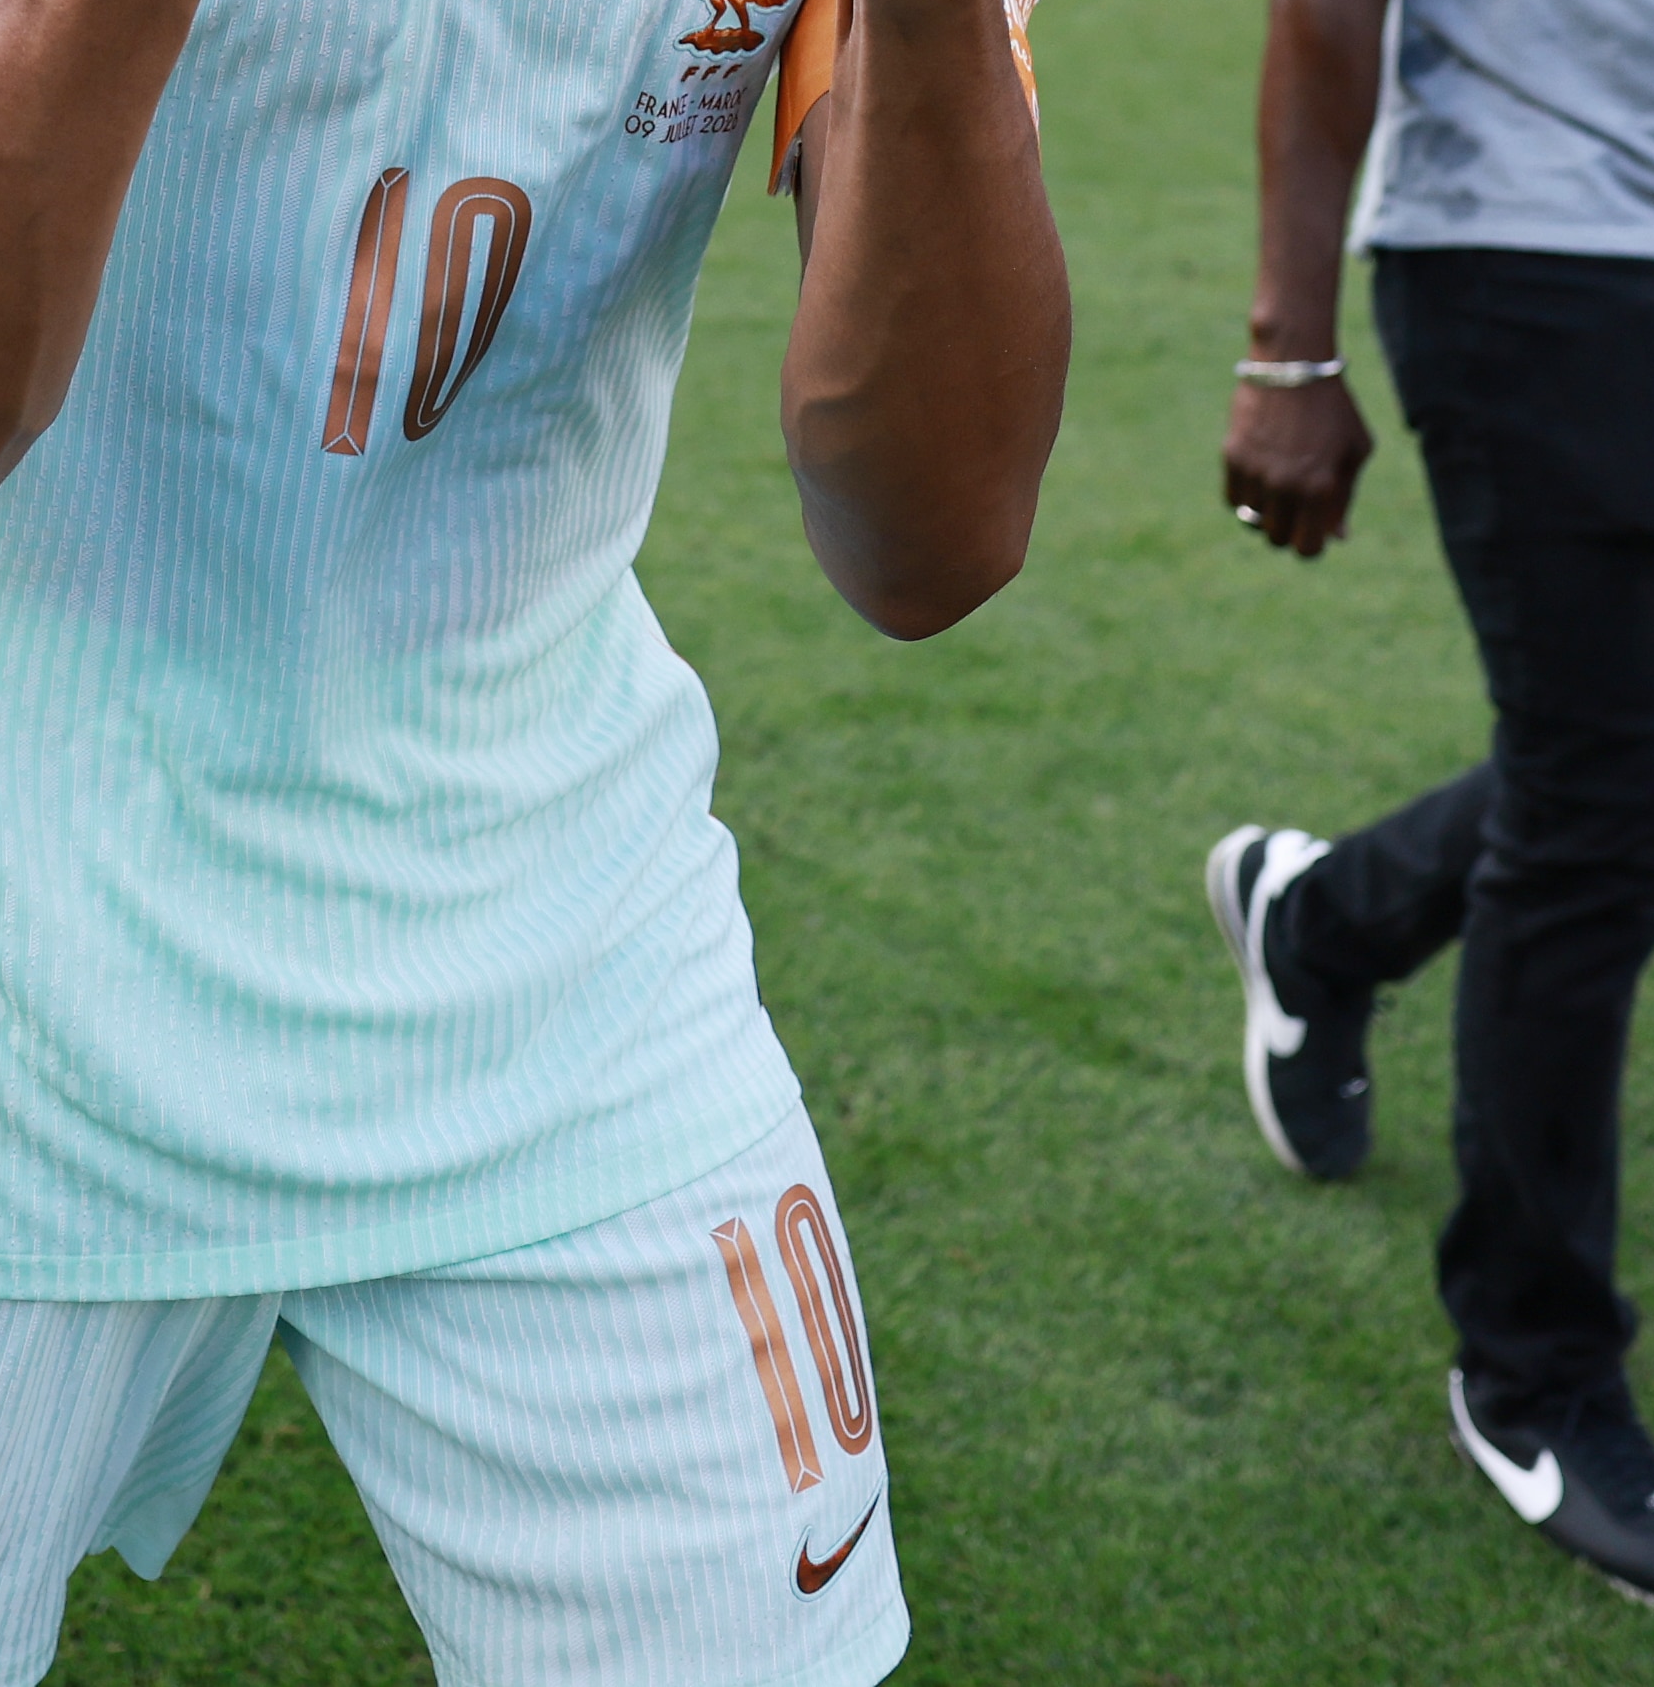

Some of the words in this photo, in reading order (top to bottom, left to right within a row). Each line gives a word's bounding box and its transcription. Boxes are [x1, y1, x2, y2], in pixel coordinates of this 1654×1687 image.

[625, 115, 655, 138] 09
[321, 167, 533, 456] 10
[710, 1184, 872, 1494] 10
